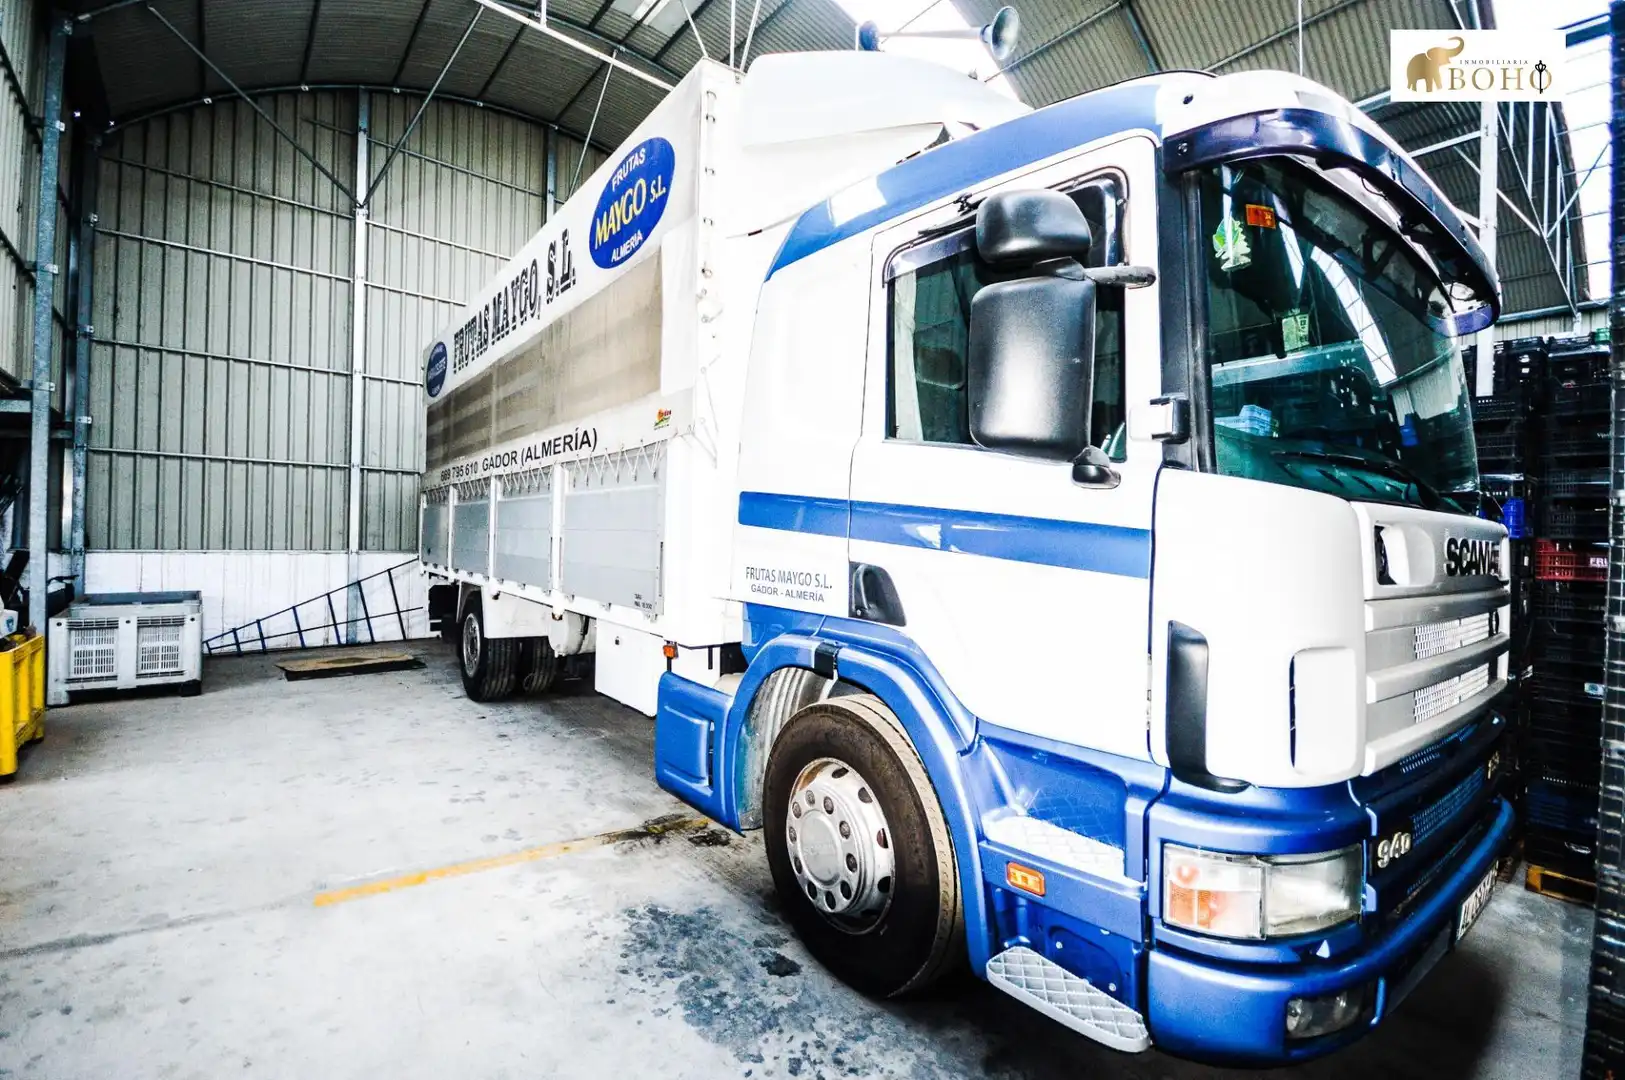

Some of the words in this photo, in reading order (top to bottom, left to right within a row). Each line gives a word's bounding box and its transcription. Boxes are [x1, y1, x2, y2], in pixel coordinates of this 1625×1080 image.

[611, 147, 646, 192] FRUTAS
[594, 178, 647, 250] MAYGO
[453, 303, 490, 374] FRUTAS
[465, 461, 478, 476] 610
[521, 427, 597, 467] (ALMERÍA)
[746, 566, 776, 582] FRUTAS
[777, 570, 812, 587] MAYGO
